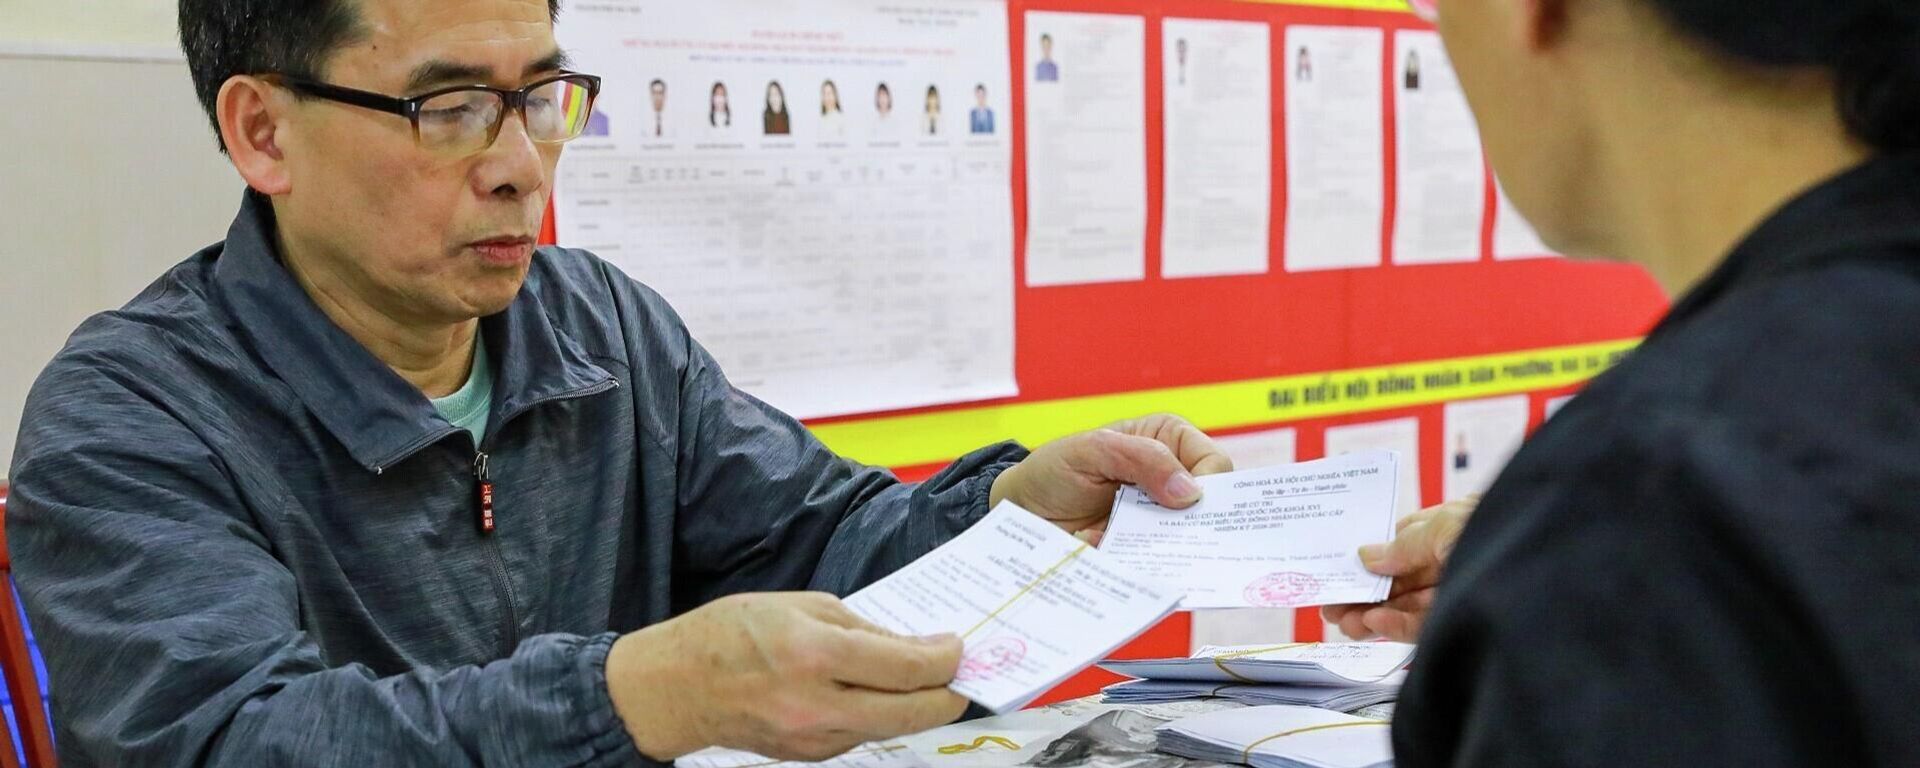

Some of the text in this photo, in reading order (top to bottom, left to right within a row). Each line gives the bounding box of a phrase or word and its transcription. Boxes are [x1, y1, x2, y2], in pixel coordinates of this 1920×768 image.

[1233, 481, 1254, 489] CỘNG
[1273, 477, 1284, 486] XÃ
[1285, 476, 1299, 485] HỘI
[1300, 474, 1315, 483] CHỦ
[1317, 471, 1340, 480] NGHĨA
[1342, 469, 1360, 478] VIỆT
[1361, 467, 1379, 475] NAM
[1185, 511, 1200, 520] BẦU
[1201, 511, 1211, 519] CỬ
[1228, 509, 1245, 517] BIỂU
[1246, 508, 1268, 516] QUỐC
[1269, 506, 1282, 514] HỘI
[1307, 503, 1321, 511] XVI
[1294, 512, 1311, 520] DÂN
[1329, 508, 1344, 516] CẤP
